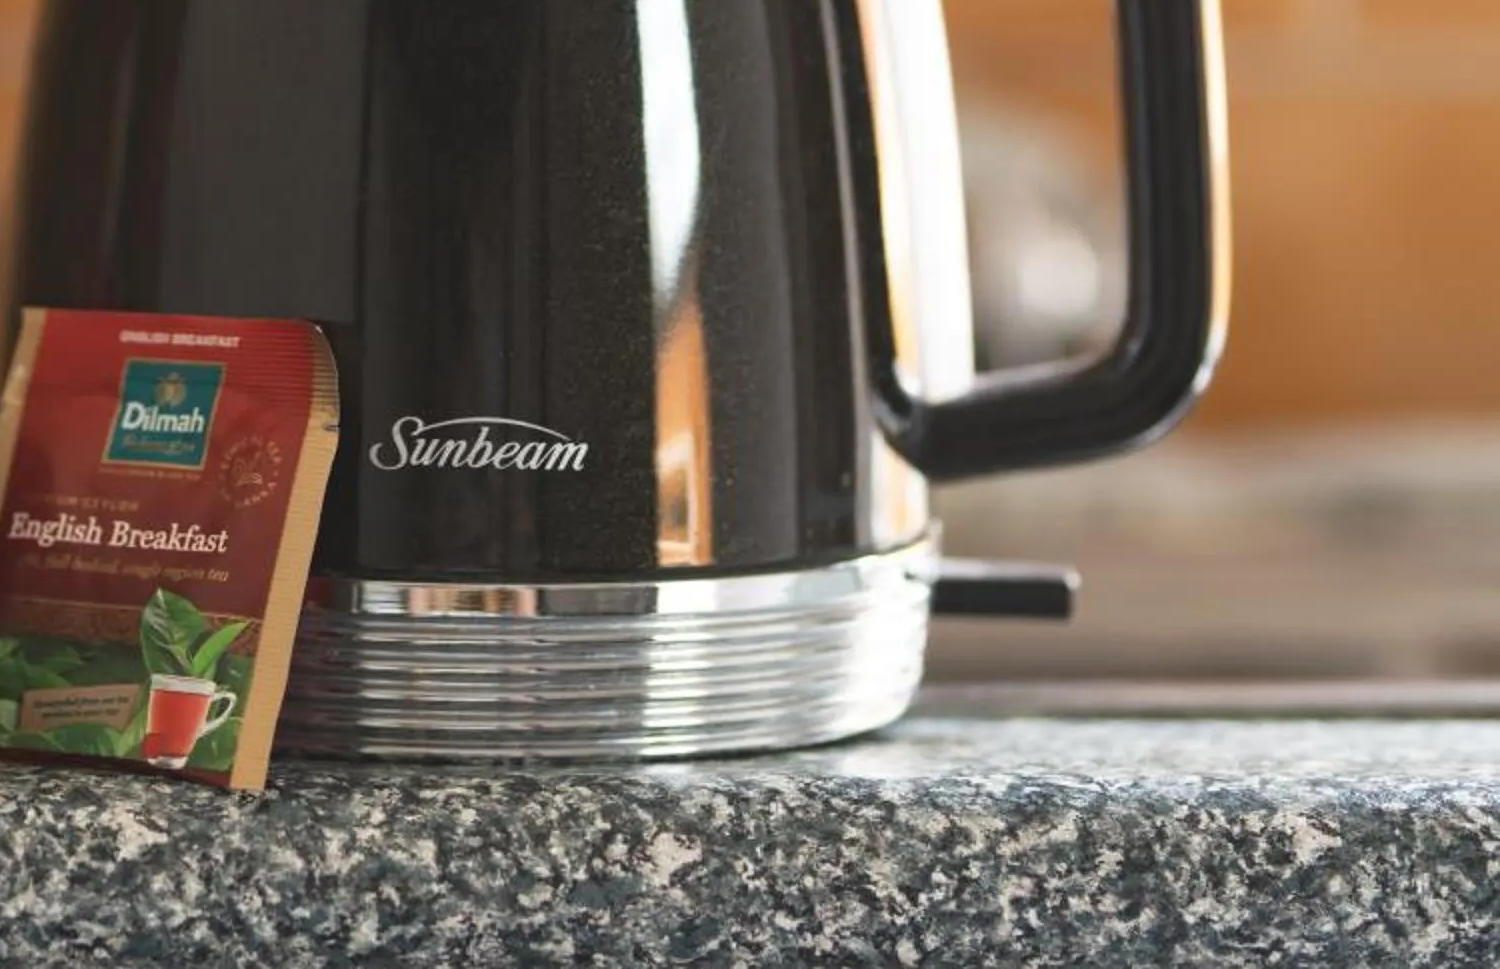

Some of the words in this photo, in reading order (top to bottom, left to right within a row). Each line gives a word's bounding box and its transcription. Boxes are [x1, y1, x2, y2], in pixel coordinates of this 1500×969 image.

[121, 401, 205, 433] Dilmah
[369, 416, 589, 471] Sunbeam
[7, 511, 102, 547] English
[107, 519, 229, 553] Breakfast
